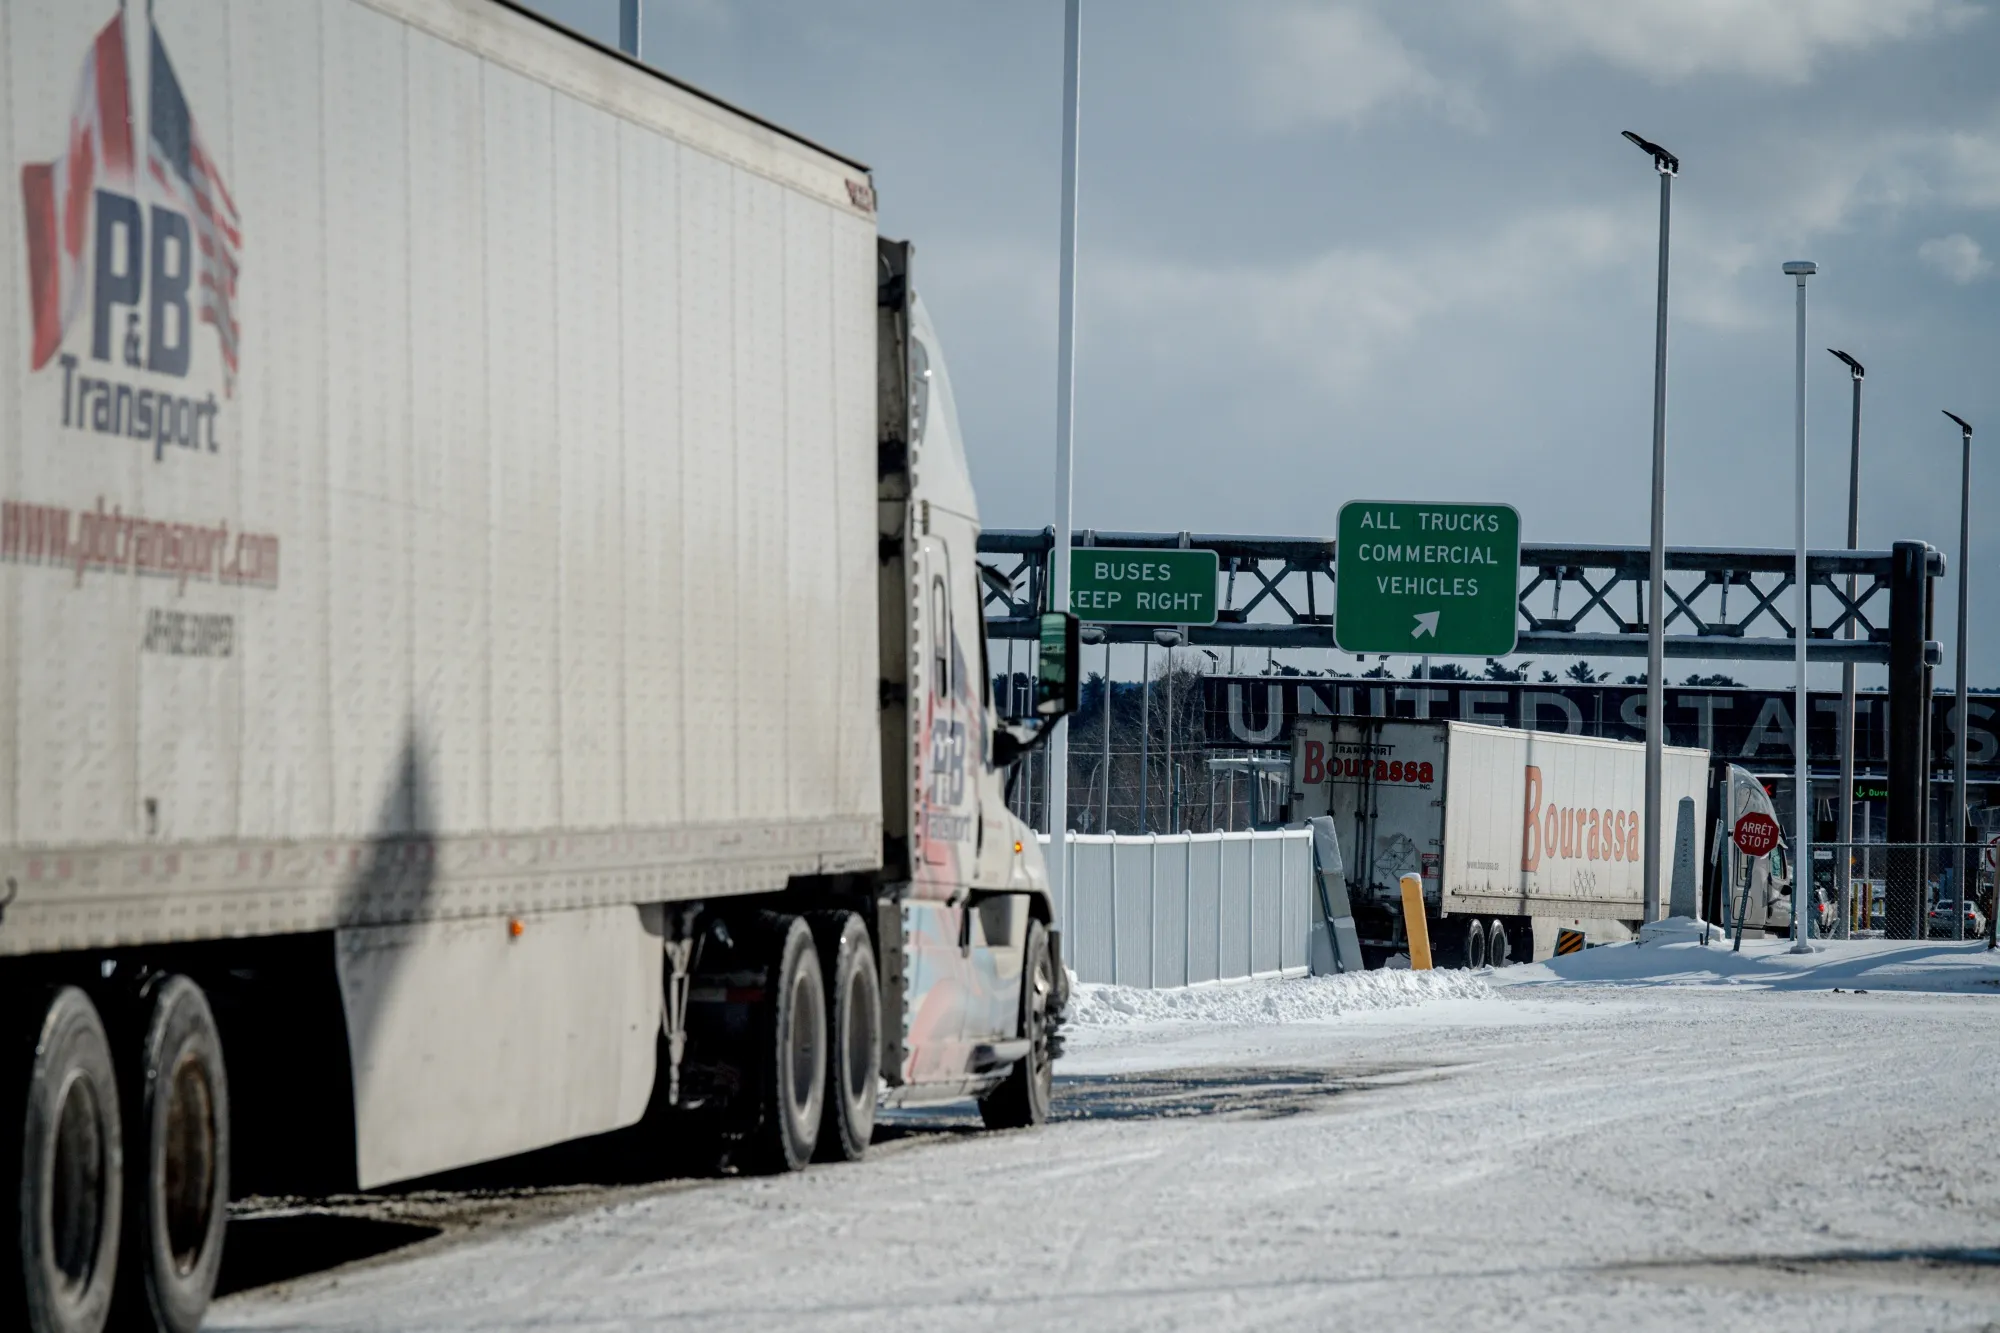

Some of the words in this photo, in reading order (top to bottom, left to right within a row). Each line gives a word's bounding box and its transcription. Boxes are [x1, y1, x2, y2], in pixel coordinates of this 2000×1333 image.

[58, 352, 221, 463] Transport
[1360, 511, 1401, 530] ALL
[1418, 512, 1500, 533] TRUCKS
[1358, 543, 1498, 565] COMMERCIAL
[1094, 562, 1172, 582] BUSES
[1376, 576, 1479, 597] VEHICLES
[1136, 592, 1203, 611] RIGHT
[1619, 693, 1999, 764] STATS
[1302, 740, 1435, 785] Bourassa
[1521, 764, 1640, 873] Bourassa
[1741, 821, 1774, 837] ARRÊT
[1740, 834, 1771, 849] STOP
